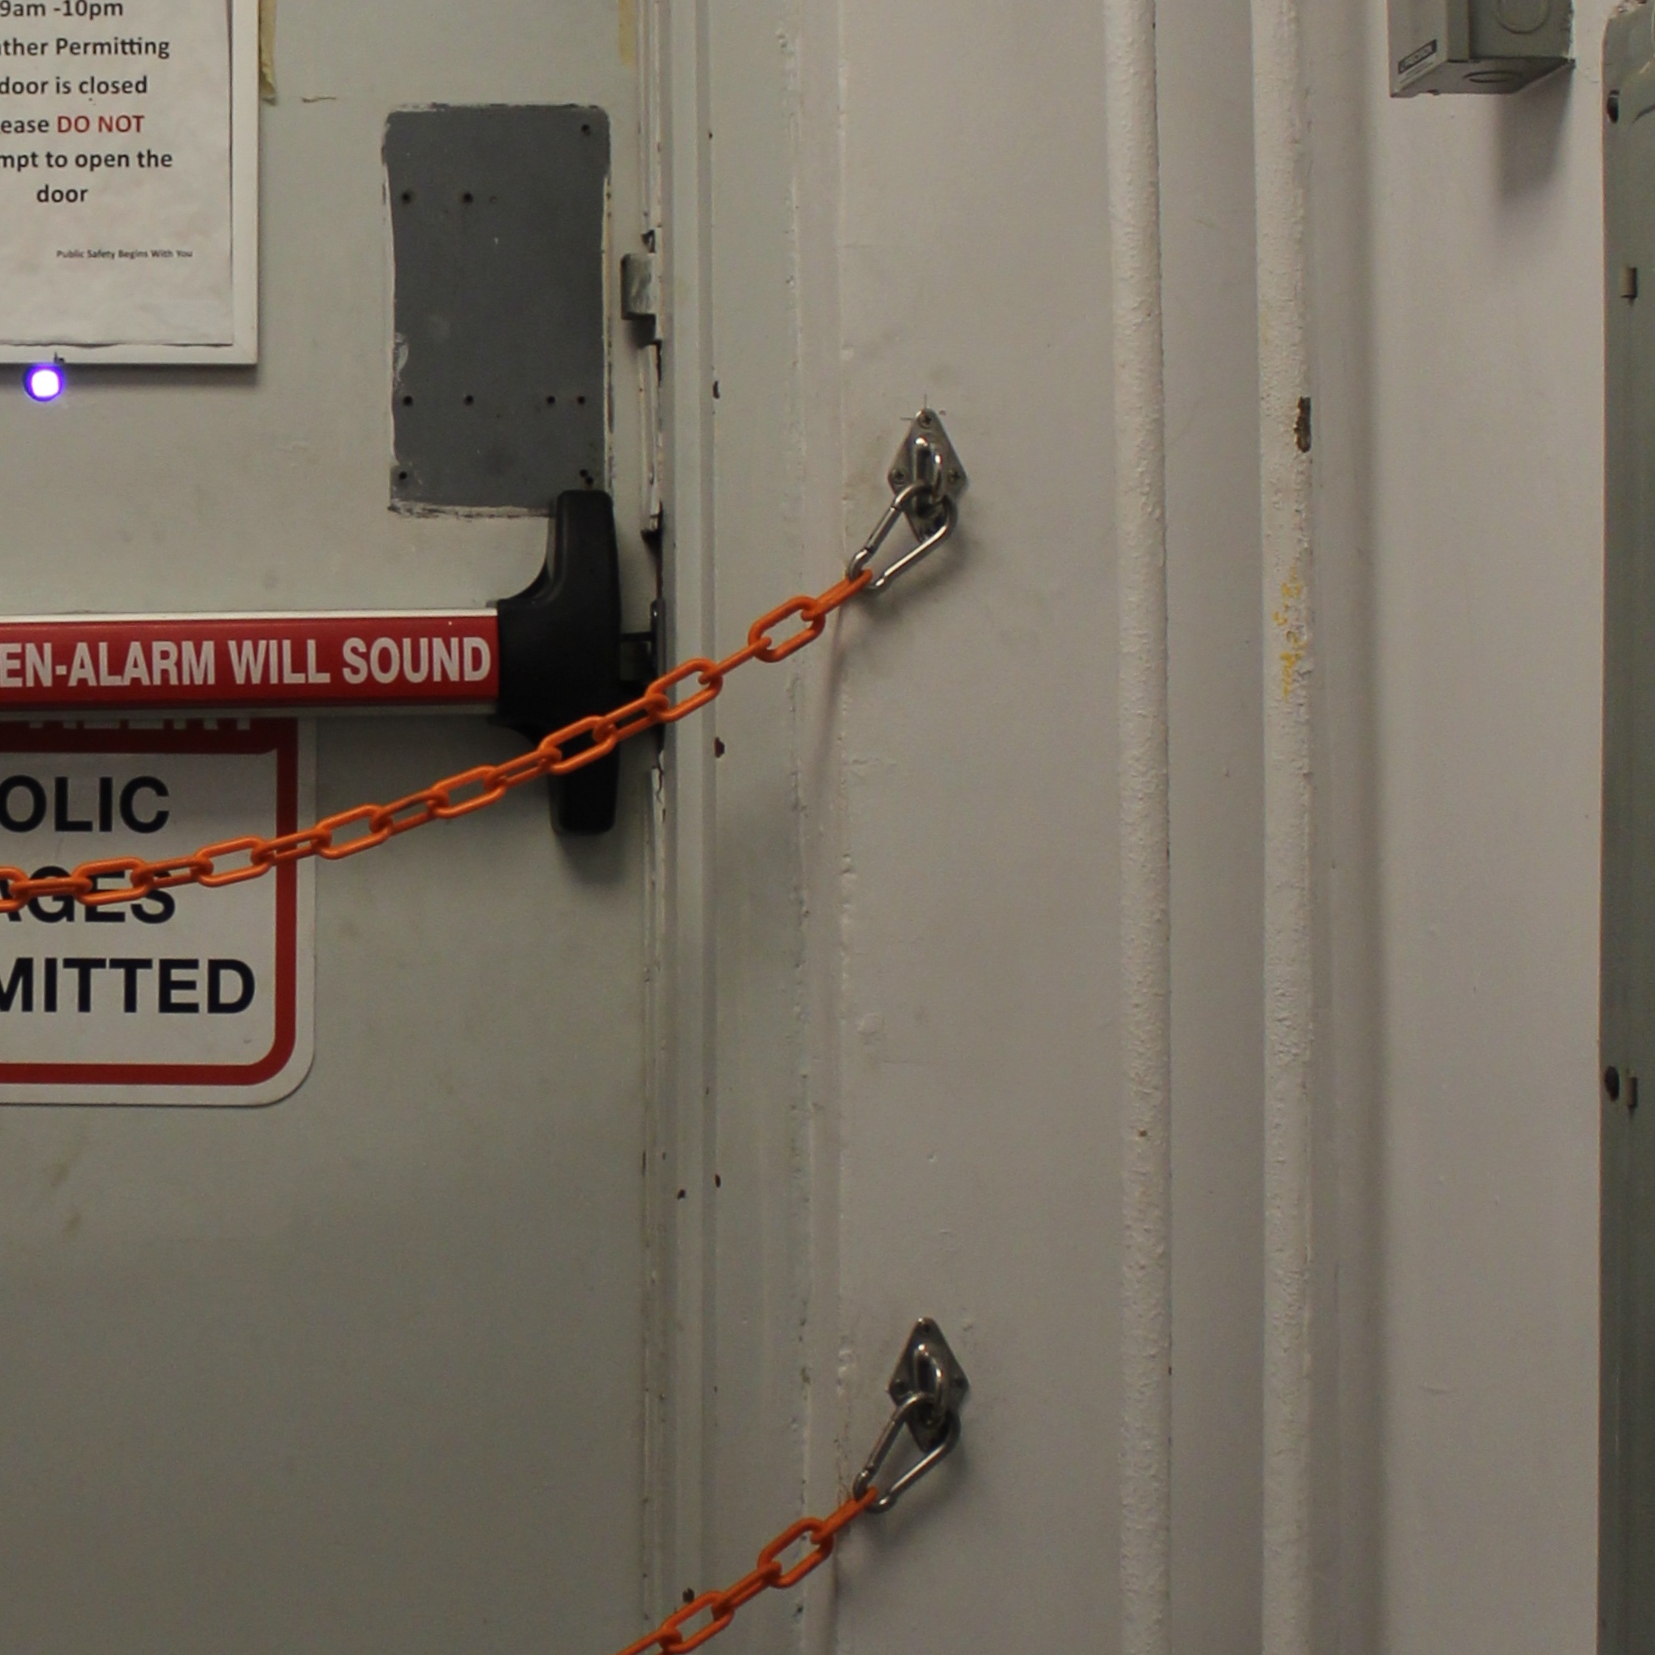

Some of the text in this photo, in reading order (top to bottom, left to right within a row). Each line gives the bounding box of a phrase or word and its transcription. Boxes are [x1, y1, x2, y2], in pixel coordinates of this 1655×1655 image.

[55, 37, 170, 60] Permitting
[55, 75, 72, 95] is
[78, 74, 148, 95] closed
[57, 115, 91, 134] DO
[98, 114, 145, 134] NOT
[45, 151, 68, 169] to
[74, 153, 130, 172] open
[136, 148, 173, 169] the
[36, 183, 89, 203] door
[86, 248, 116, 260] Safety
[226, 638, 331, 685] WILL
[342, 636, 491, 684] SOUND
